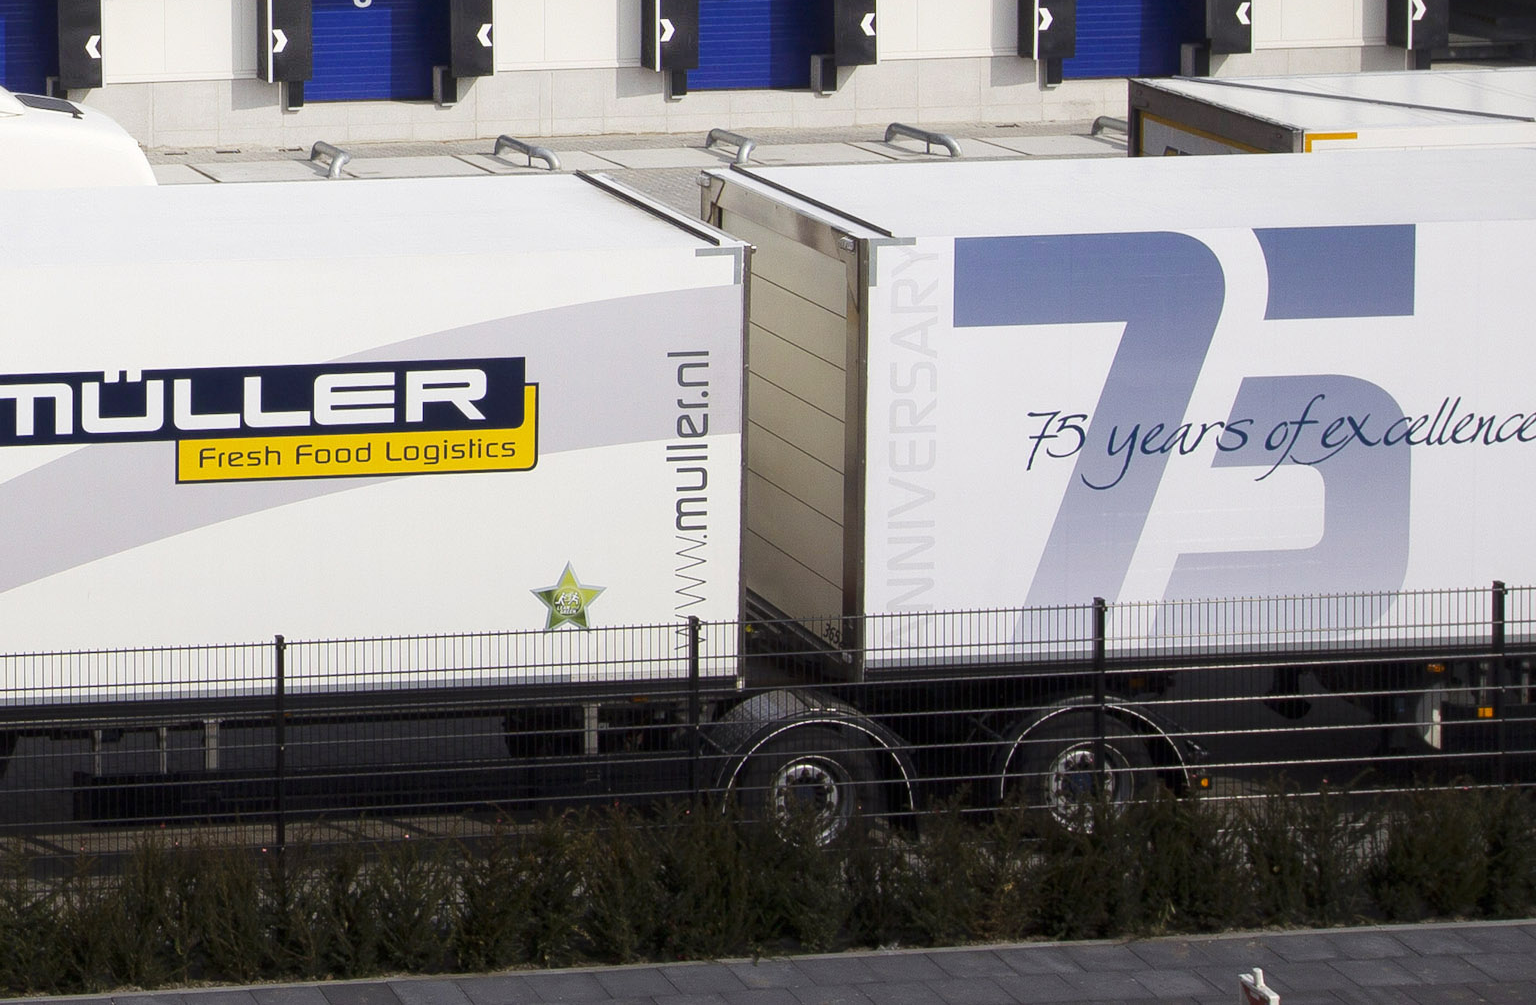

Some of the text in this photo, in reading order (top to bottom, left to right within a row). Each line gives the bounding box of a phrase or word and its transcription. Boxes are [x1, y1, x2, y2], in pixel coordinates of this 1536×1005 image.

[199, 437, 517, 468] Fresh Food Logistics
[666, 351, 710, 651] www.muller.nl
[886, 247, 939, 648] ANNIVERSARY
[953, 224, 1416, 650] 75
[1026, 394, 1536, 490] 75 years of excellence
